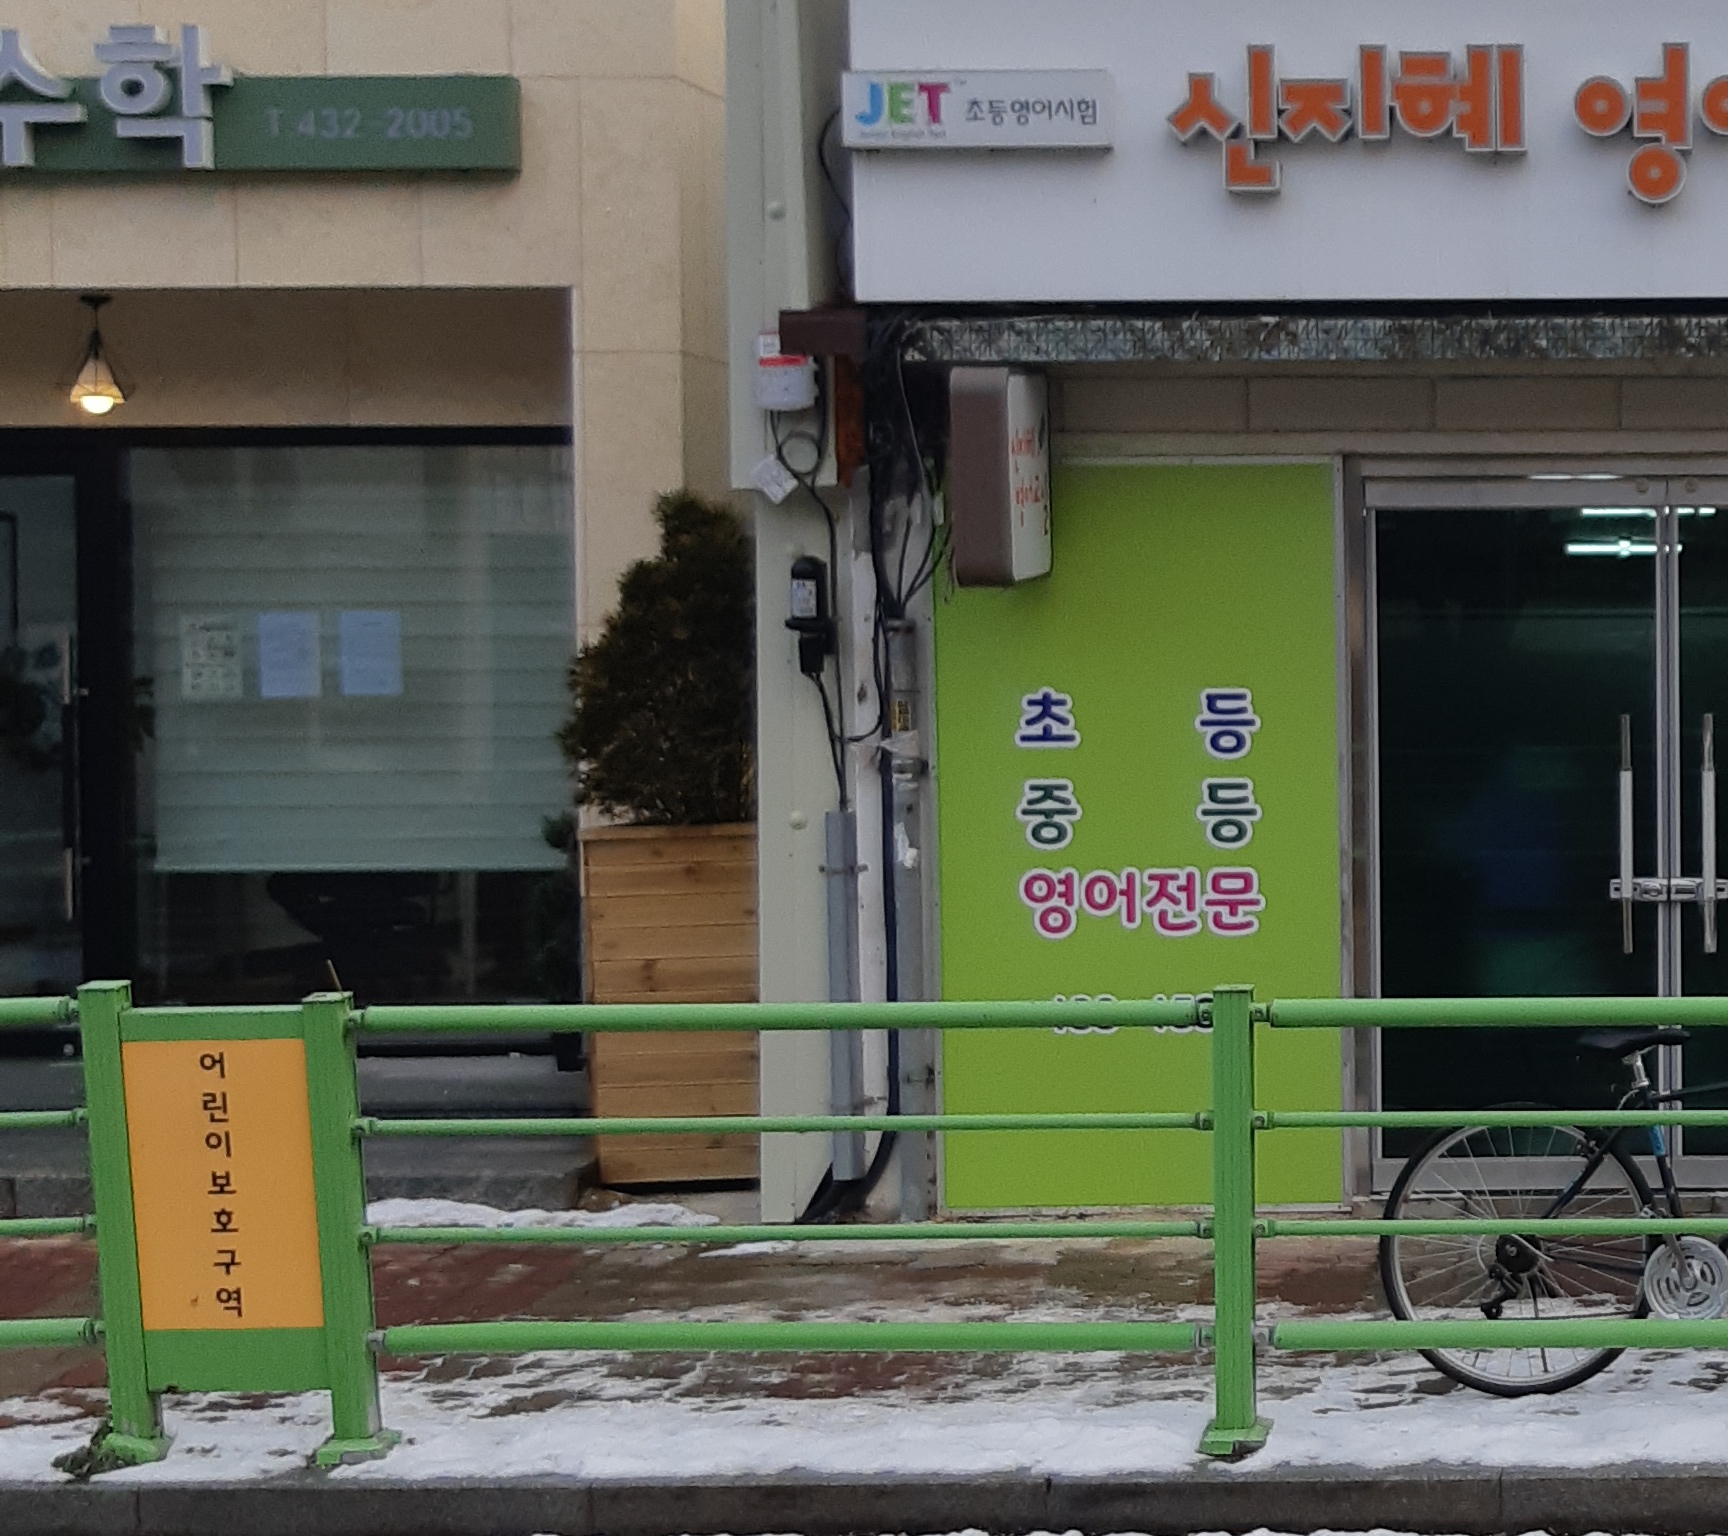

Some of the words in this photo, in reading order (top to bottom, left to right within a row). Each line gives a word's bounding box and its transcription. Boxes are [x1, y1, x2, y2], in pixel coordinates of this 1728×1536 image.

[855, 81, 950, 127] JET
[964, 98, 1098, 126] 초등영어시험
[1167, 44, 1528, 193] 신지혜
[1018, 867, 1266, 939] 영어전문
